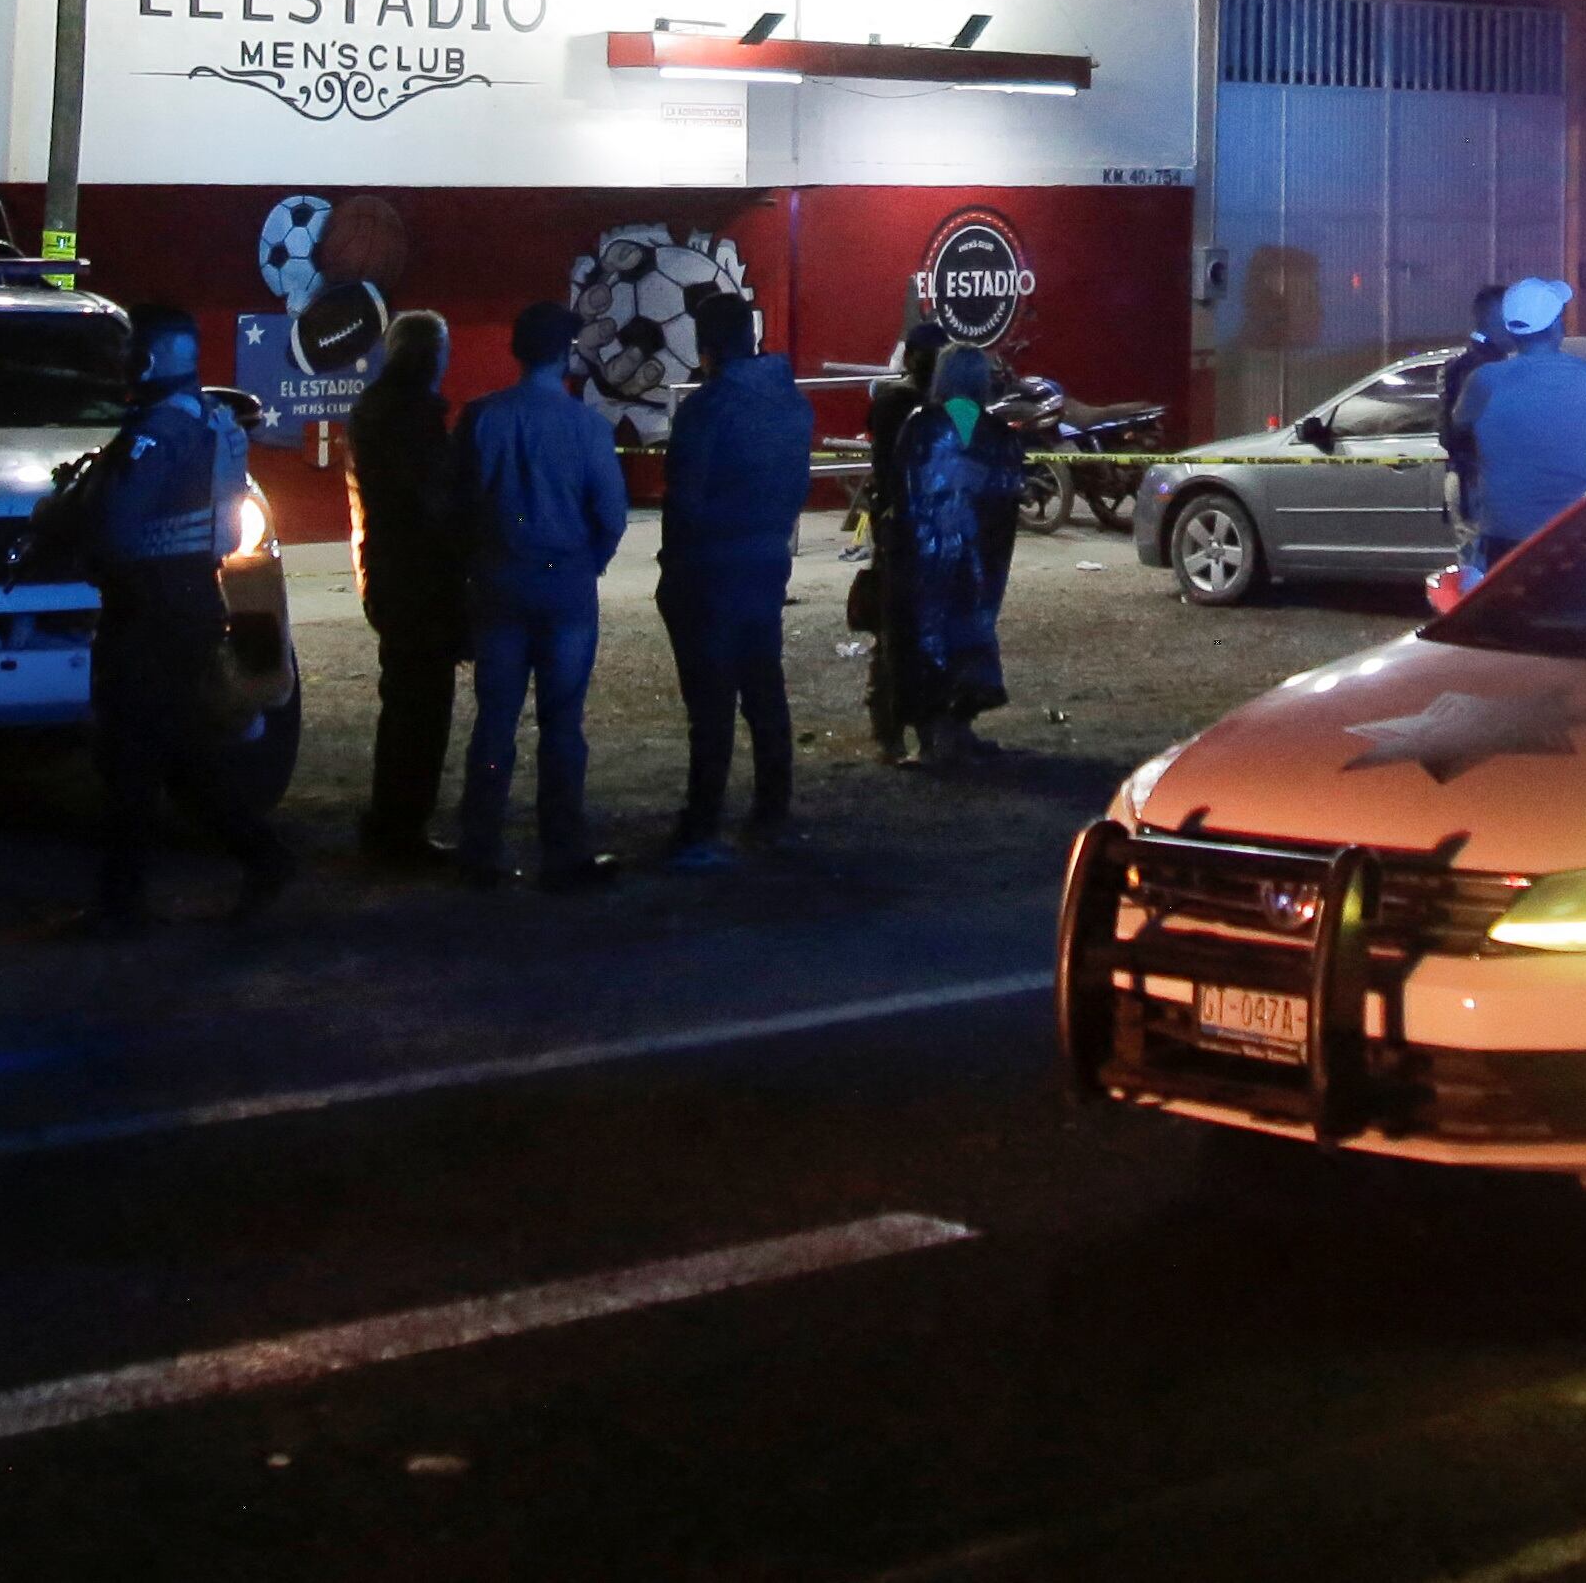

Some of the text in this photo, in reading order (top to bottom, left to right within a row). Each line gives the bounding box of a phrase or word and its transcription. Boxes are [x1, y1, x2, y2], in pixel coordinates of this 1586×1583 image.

[240, 39, 466, 76] MEN'S CLUB
[916, 269, 1036, 299] EL ESTADIO
[280, 378, 365, 398] EL ESTADIO
